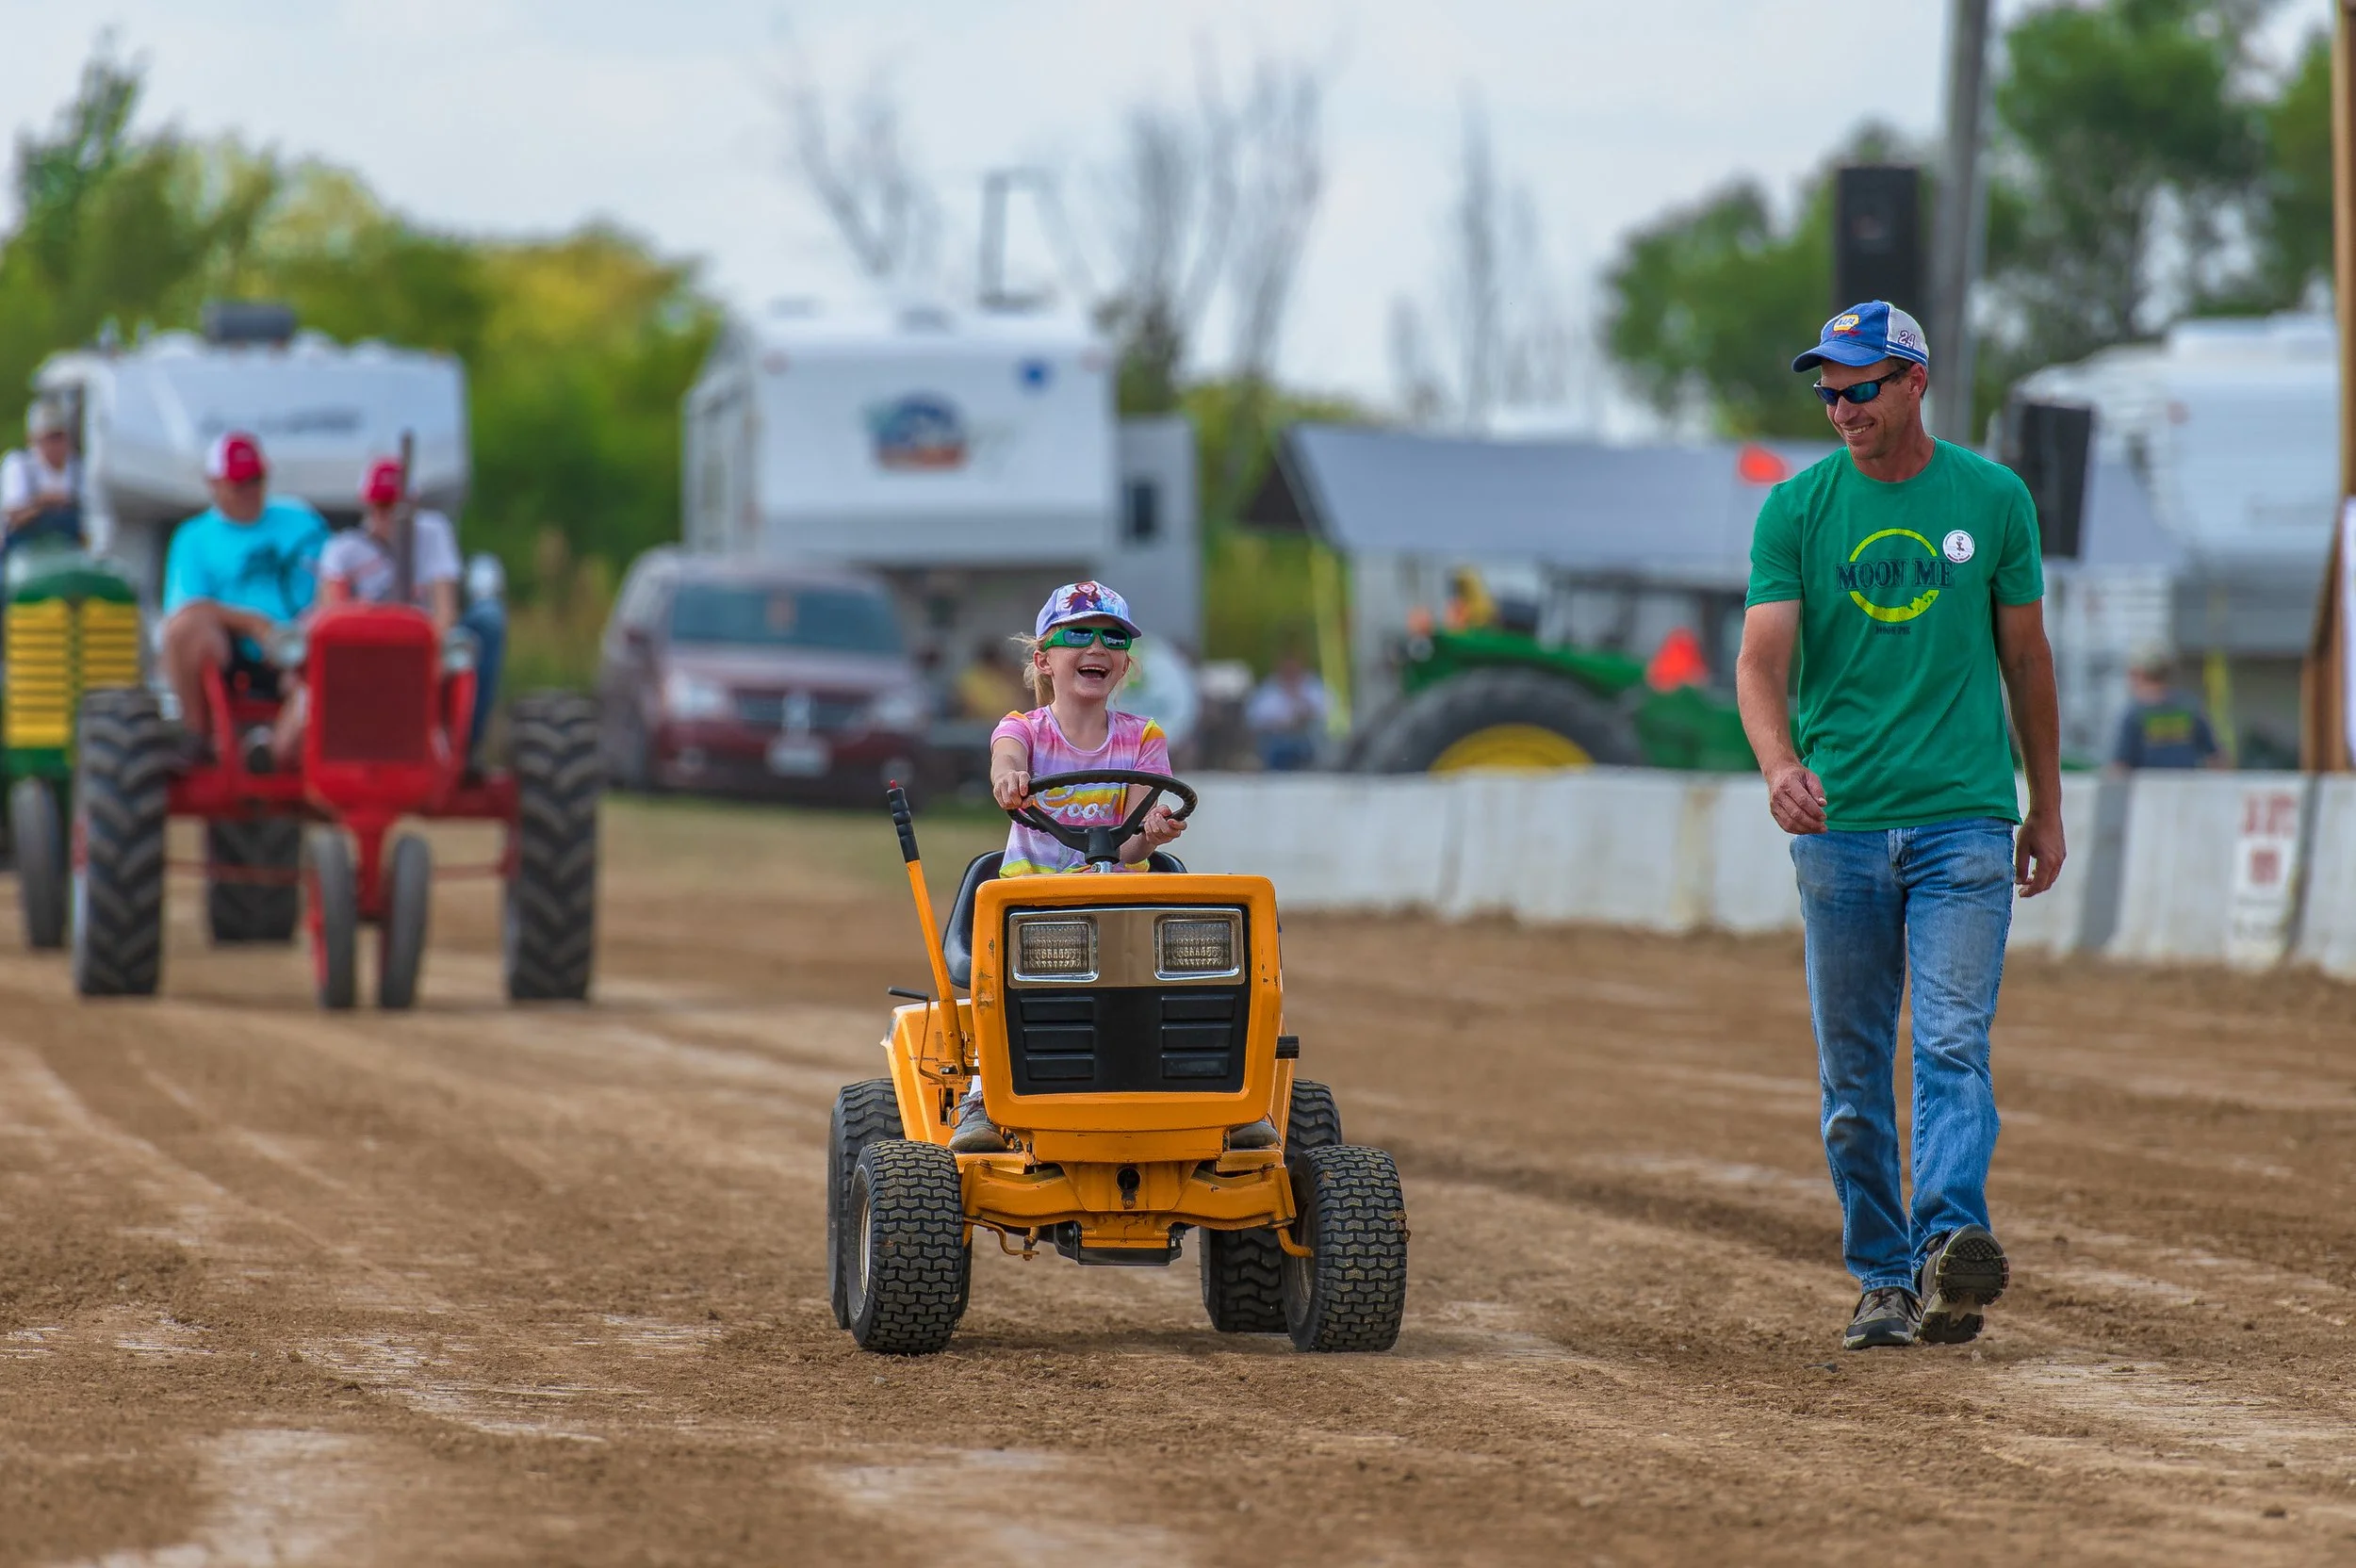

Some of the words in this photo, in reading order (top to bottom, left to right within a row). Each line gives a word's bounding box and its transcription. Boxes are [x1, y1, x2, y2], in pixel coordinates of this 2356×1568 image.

[1898, 330, 1916, 349] 24
[1835, 559, 1907, 591] MOON
[1913, 559, 1955, 588] ME
[1037, 786, 1119, 821] Good
